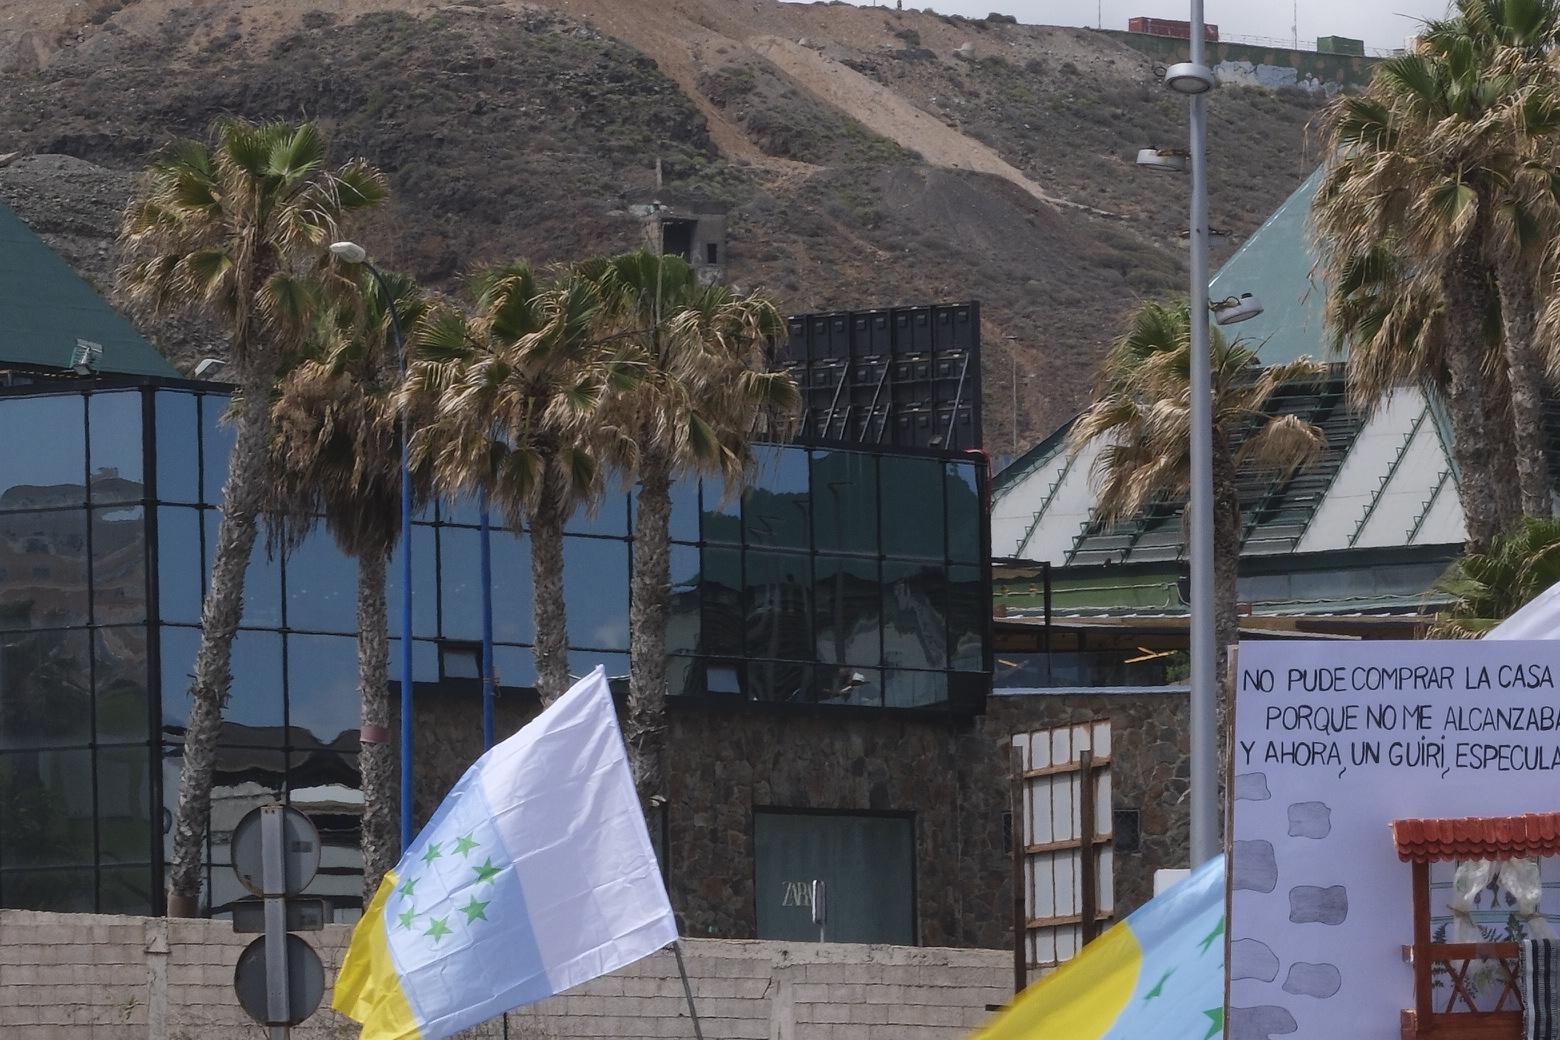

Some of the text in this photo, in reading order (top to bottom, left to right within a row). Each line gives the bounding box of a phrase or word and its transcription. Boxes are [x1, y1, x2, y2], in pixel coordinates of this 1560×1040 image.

[1243, 668, 1275, 692] NO
[1287, 667, 1347, 692] PUDE
[1351, 666, 1455, 691] COMPRAR
[1465, 665, 1491, 690] LA
[1498, 664, 1554, 689] CASA
[1266, 704, 1360, 736] PORQUE
[1366, 703, 1397, 731] NO
[1402, 704, 1433, 731] ME
[1240, 740, 1256, 766] Y
[1264, 740, 1347, 779] AHORA,
[1351, 741, 1380, 766] UN
